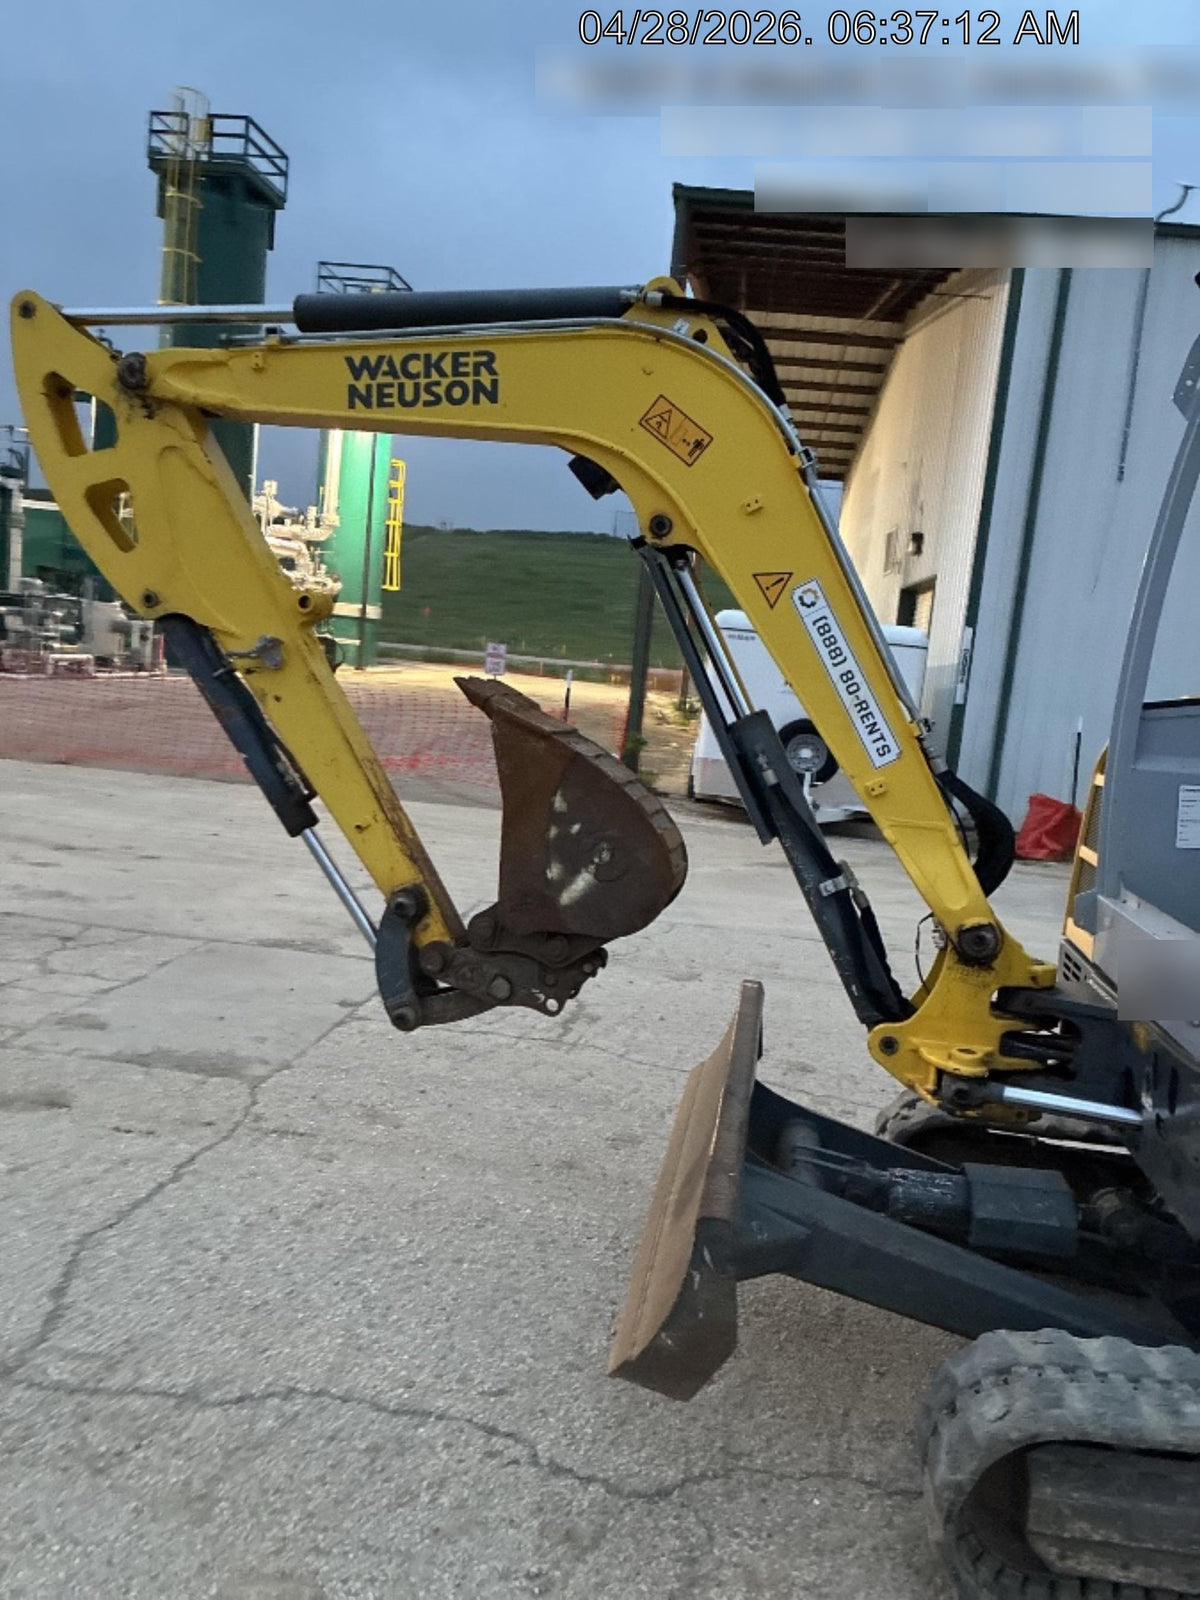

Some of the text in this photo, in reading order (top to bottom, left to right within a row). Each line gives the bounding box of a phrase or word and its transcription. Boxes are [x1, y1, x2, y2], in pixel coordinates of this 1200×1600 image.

[345, 350, 498, 381] WACKER
[348, 378, 499, 409] NEUSON
[839, 669, 891, 757] 80-RENTS
